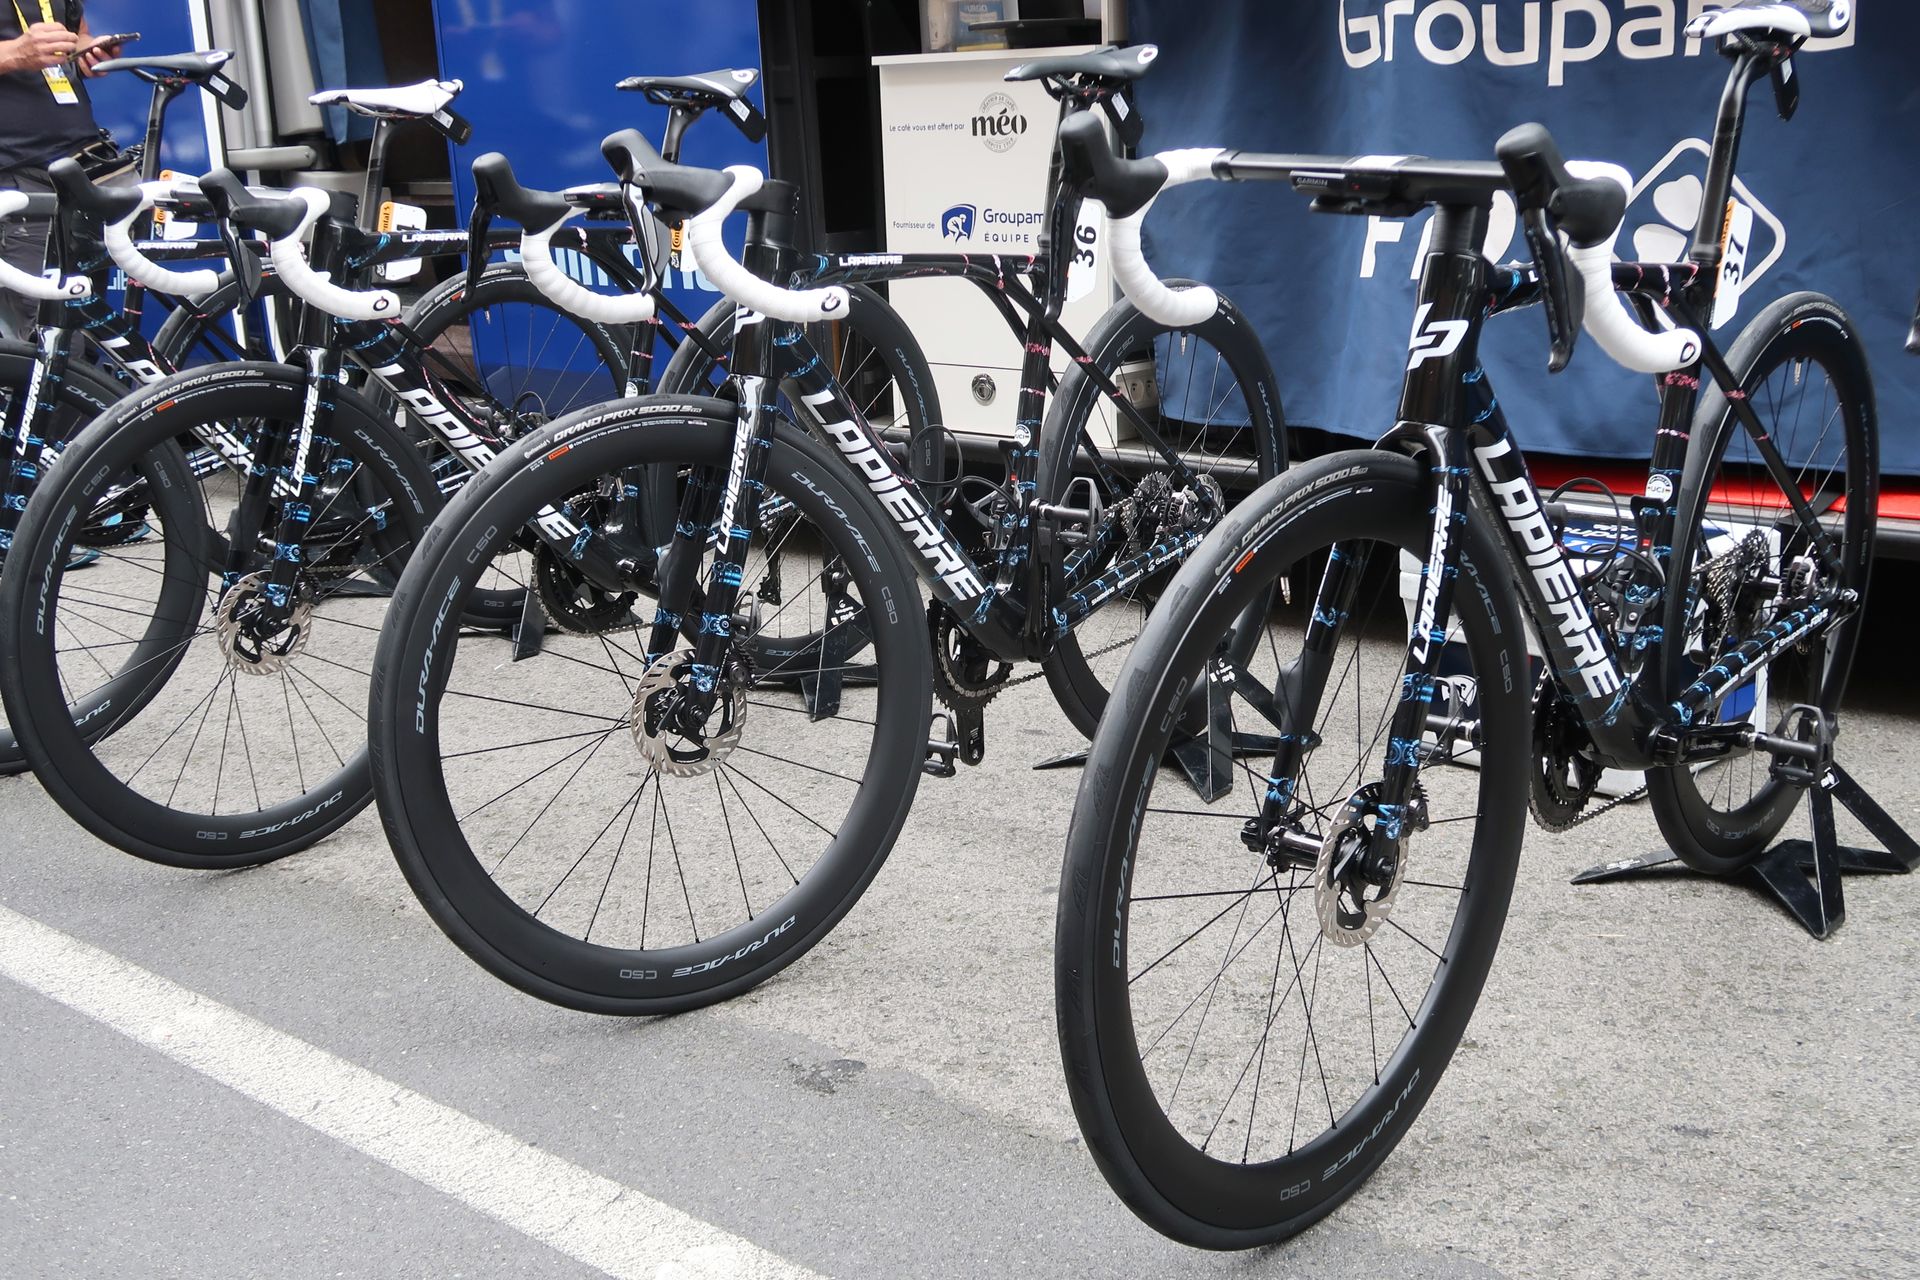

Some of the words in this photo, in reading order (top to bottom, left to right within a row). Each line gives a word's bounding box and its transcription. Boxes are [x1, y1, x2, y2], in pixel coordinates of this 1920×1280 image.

[1338, 0, 1855, 86] Groupa
[898, 123, 911, 132] café
[912, 123, 926, 131] vous
[937, 122, 953, 131] offert
[954, 123, 965, 132] par
[971, 107, 1028, 136] méo
[893, 221, 925, 229] Fournisseur
[983, 208, 1044, 227] Groupam
[984, 233, 1030, 243] ÉQUIPE
[1074, 224, 1097, 269] 36
[839, 255, 903, 267] LAPIERRE
[1723, 233, 1745, 286] 37
[141, 384, 181, 409] GRAND
[181, 375, 211, 391] PRIX
[210, 371, 245, 382] 5000
[290, 384, 319, 498] LAPIERRE
[553, 415, 602, 443] GRAND
[601, 407, 639, 424] PRIX
[638, 405, 680, 415] 5000
[716, 418, 750, 555] LAPIERRE
[801, 389, 987, 602] LAPIERRE
[1241, 503, 1284, 547] GRAND
[1283, 482, 1316, 511] PRIX
[1314, 470, 1350, 489] 5000
[791, 471, 882, 573] DURA-ACE
[37, 504, 78, 636] DURA-ACE
[1413, 484, 1453, 664] LAPIERRE
[1474, 438, 1622, 699] LAPIERRE
[415, 575, 461, 735] DURA-ACE
[239, 790, 343, 839] DURA-ACE
[1112, 752, 1155, 969] DURA-ACE
[619, 969, 658, 980] C50
[672, 914, 796, 978] DURA-ACE
[1321, 1067, 1420, 1182] DURA-ACE
